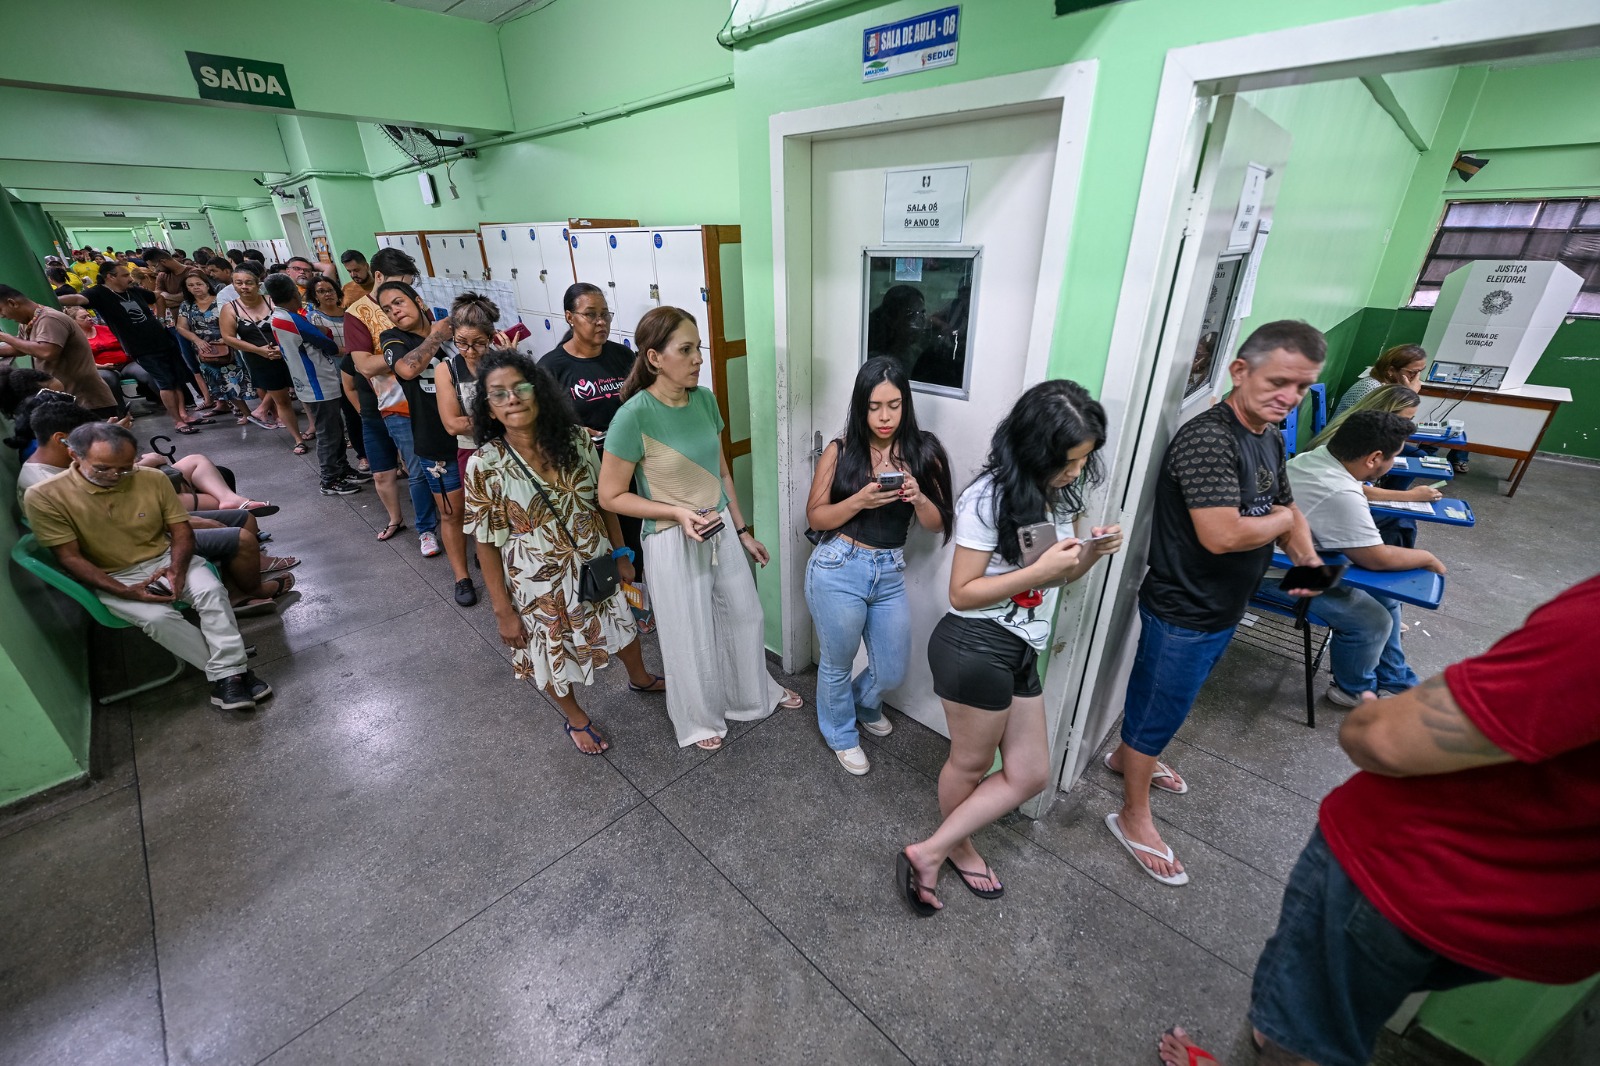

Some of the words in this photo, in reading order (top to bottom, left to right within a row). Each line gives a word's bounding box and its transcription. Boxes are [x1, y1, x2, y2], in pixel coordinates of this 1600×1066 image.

[881, 28, 901, 51] SALA
[902, 25, 914, 46] DE
[914, 19, 937, 43] AULA
[943, 14, 956, 37] 08
[927, 48, 954, 62] SEDUC
[864, 66, 889, 77] AMAZONAS
[199, 65, 287, 97] SAÍDA
[906, 203, 927, 212] SALA
[928, 201, 938, 212] 08
[913, 218, 929, 227] ANO
[929, 218, 940, 227] 02
[1495, 264, 1528, 274] JUSTIÇA
[1486, 275, 1527, 284] ELEITORAL
[1465, 331, 1489, 339] CABINA
[1465, 339, 1494, 348] VOTAÇÃO
